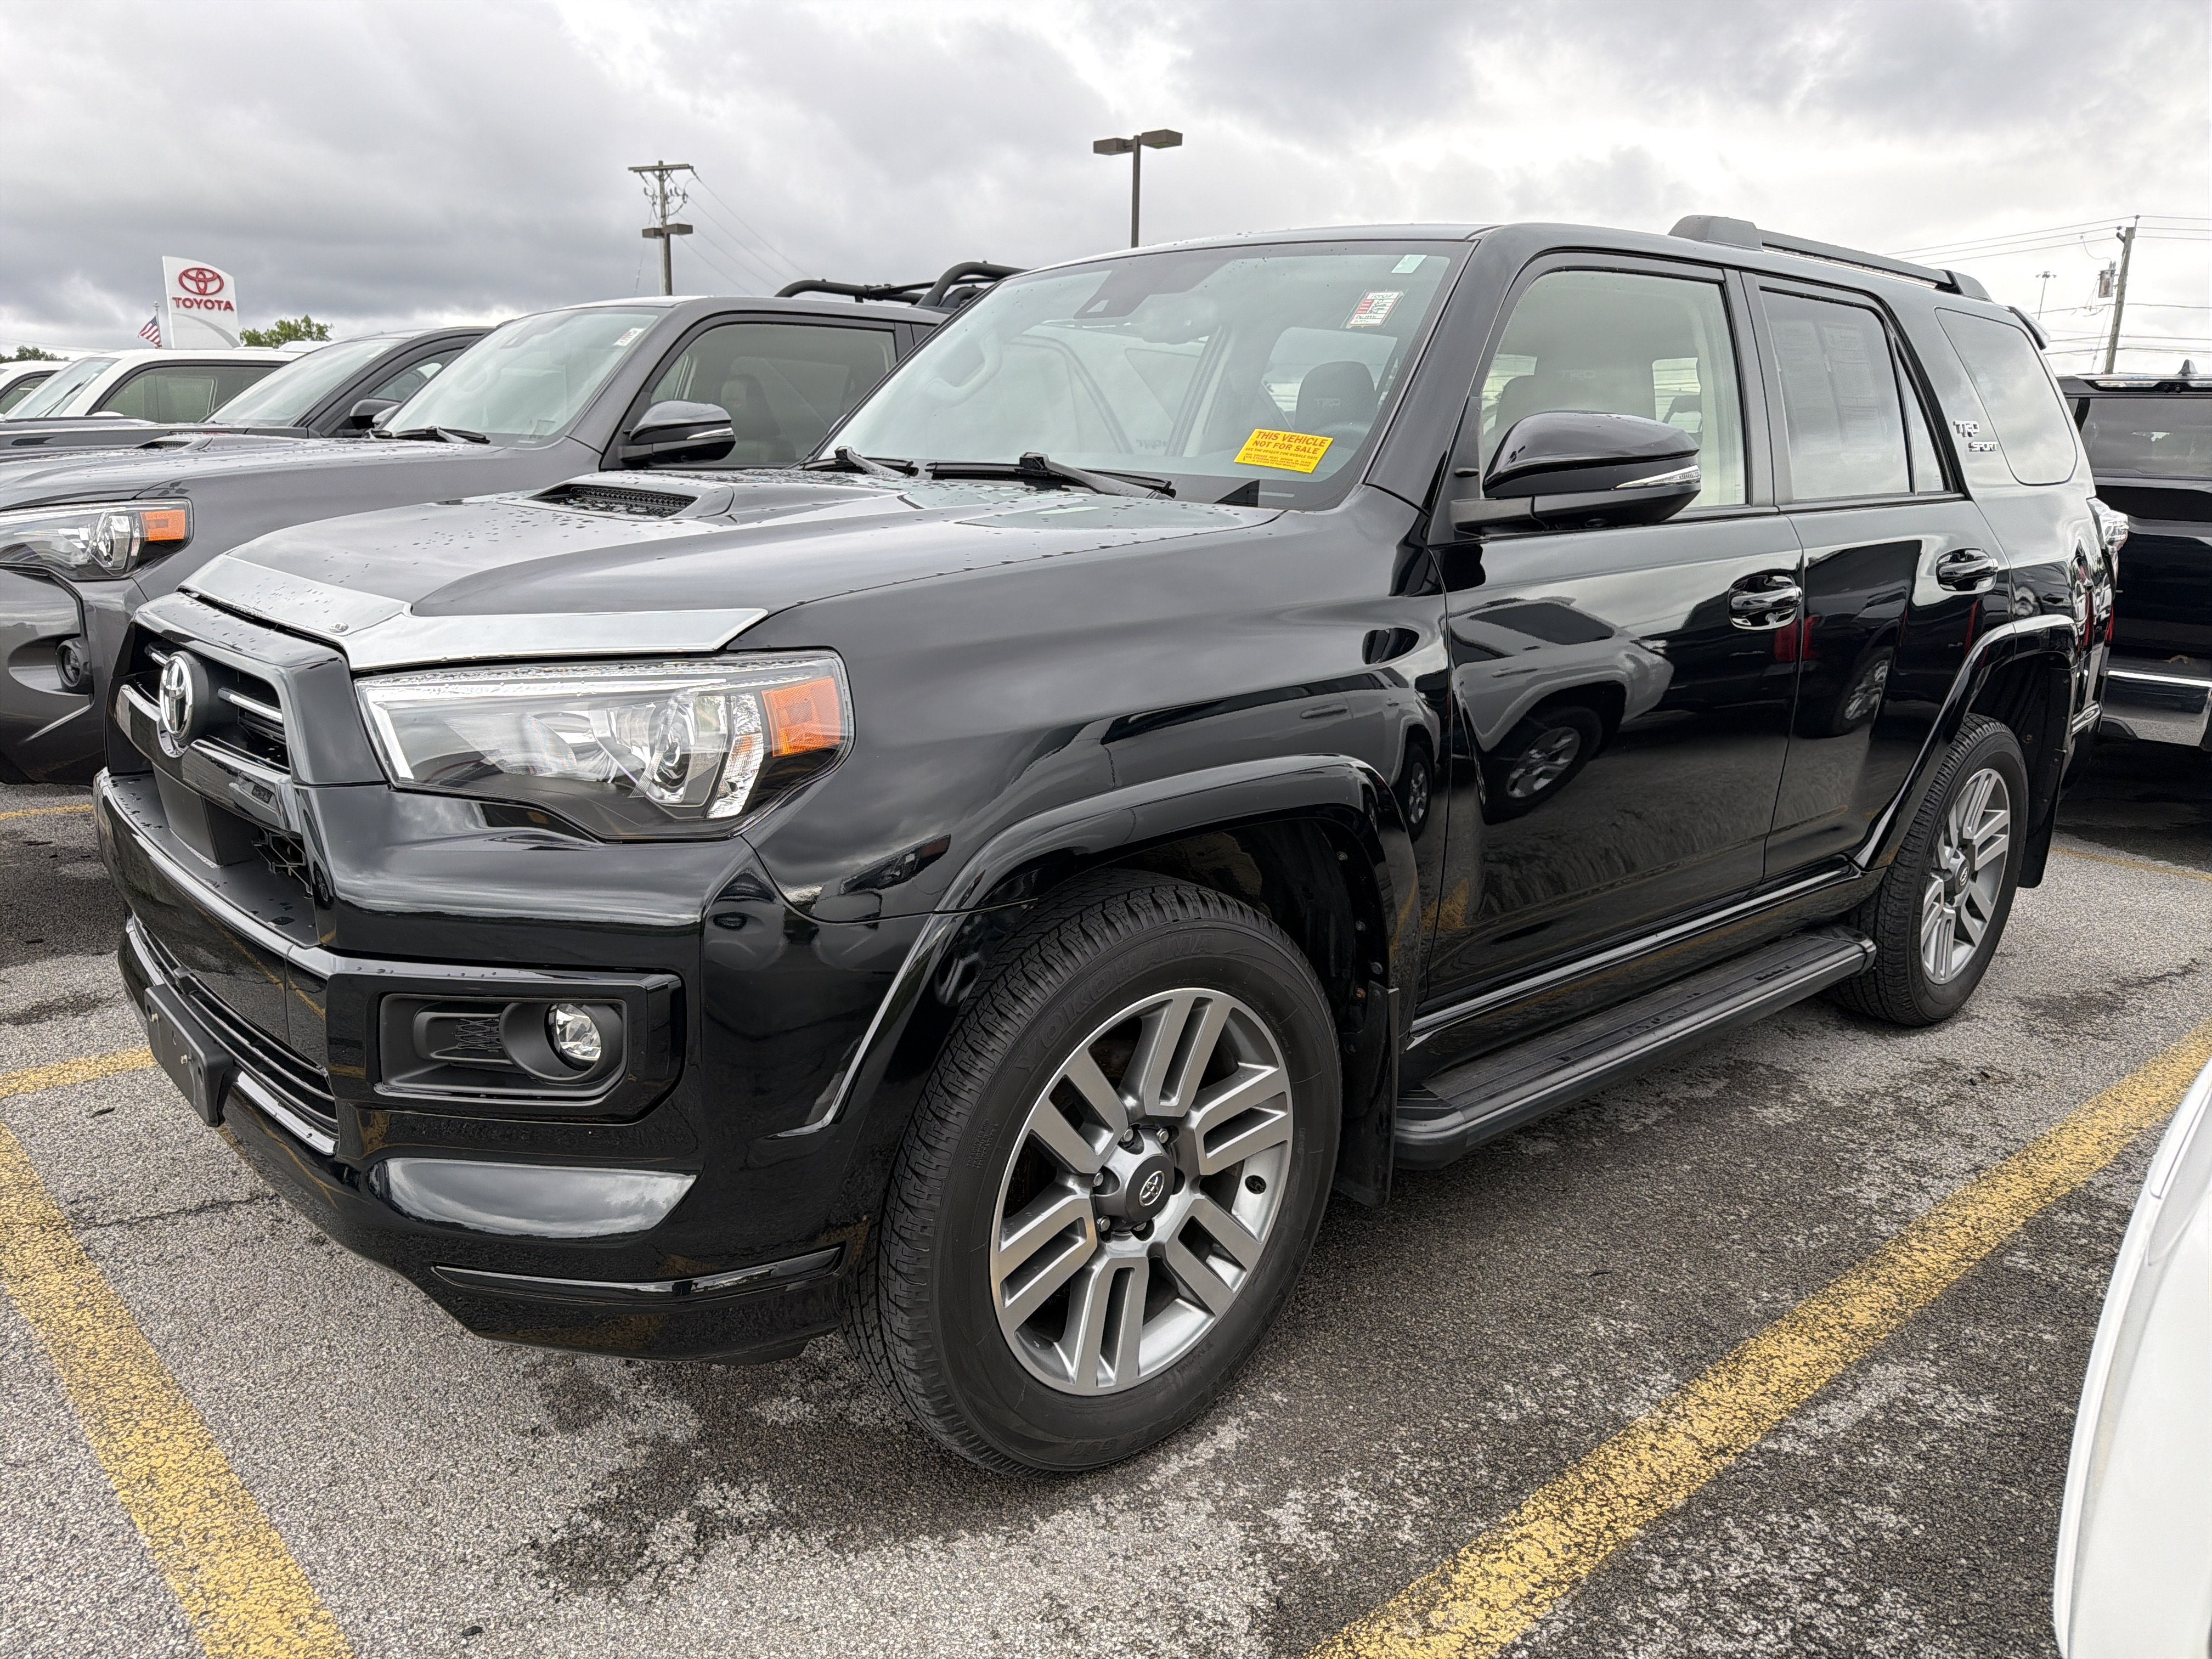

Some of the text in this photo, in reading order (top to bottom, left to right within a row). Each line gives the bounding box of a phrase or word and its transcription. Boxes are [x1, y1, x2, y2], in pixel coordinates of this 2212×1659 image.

[172, 297, 234, 312] TOYOTA
[1953, 420, 1980, 437] TRD
[1255, 431, 1328, 447] THIS VEHICLE
[1968, 441, 1997, 452] SPORT
[1273, 442, 1293, 450] FOR
[1294, 445, 1320, 454] SALE
[1015, 933, 1215, 1074] YOKOHAMA
